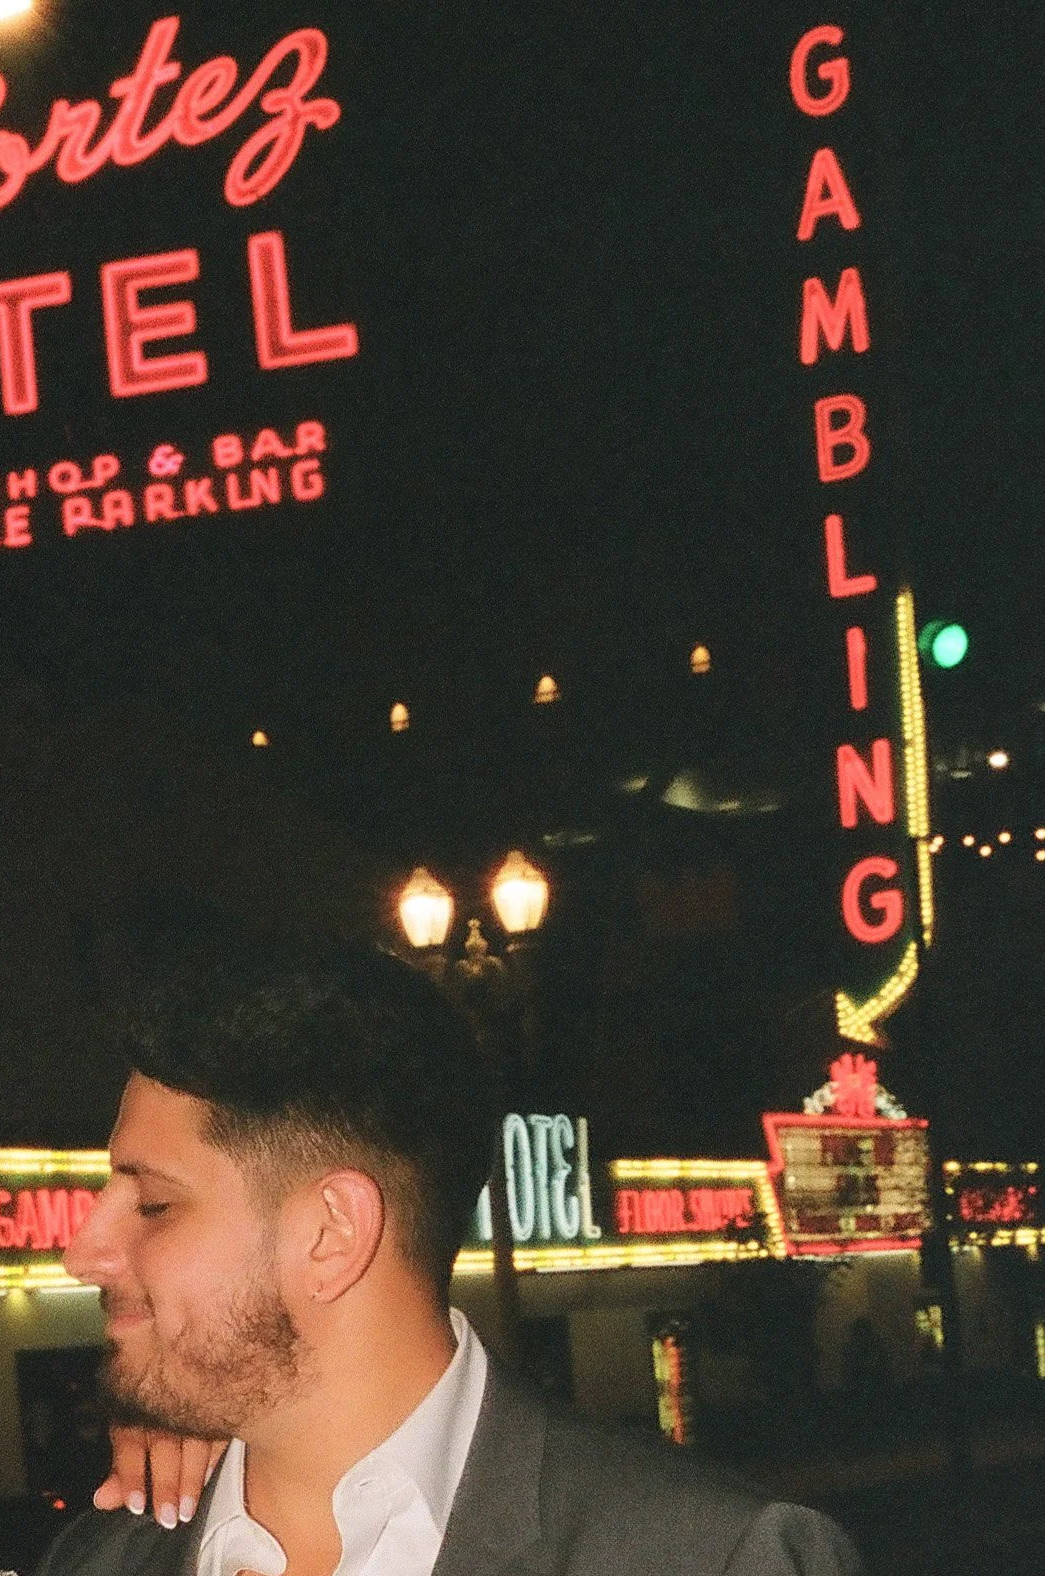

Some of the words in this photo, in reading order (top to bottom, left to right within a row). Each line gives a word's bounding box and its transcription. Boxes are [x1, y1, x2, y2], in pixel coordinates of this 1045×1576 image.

[62, 459, 324, 536] PARKING
[148, 444, 184, 475] &
[212, 420, 327, 470] BAR
[789, 25, 904, 943] GAMBLING
[476, 1113, 602, 1242] OTEL
